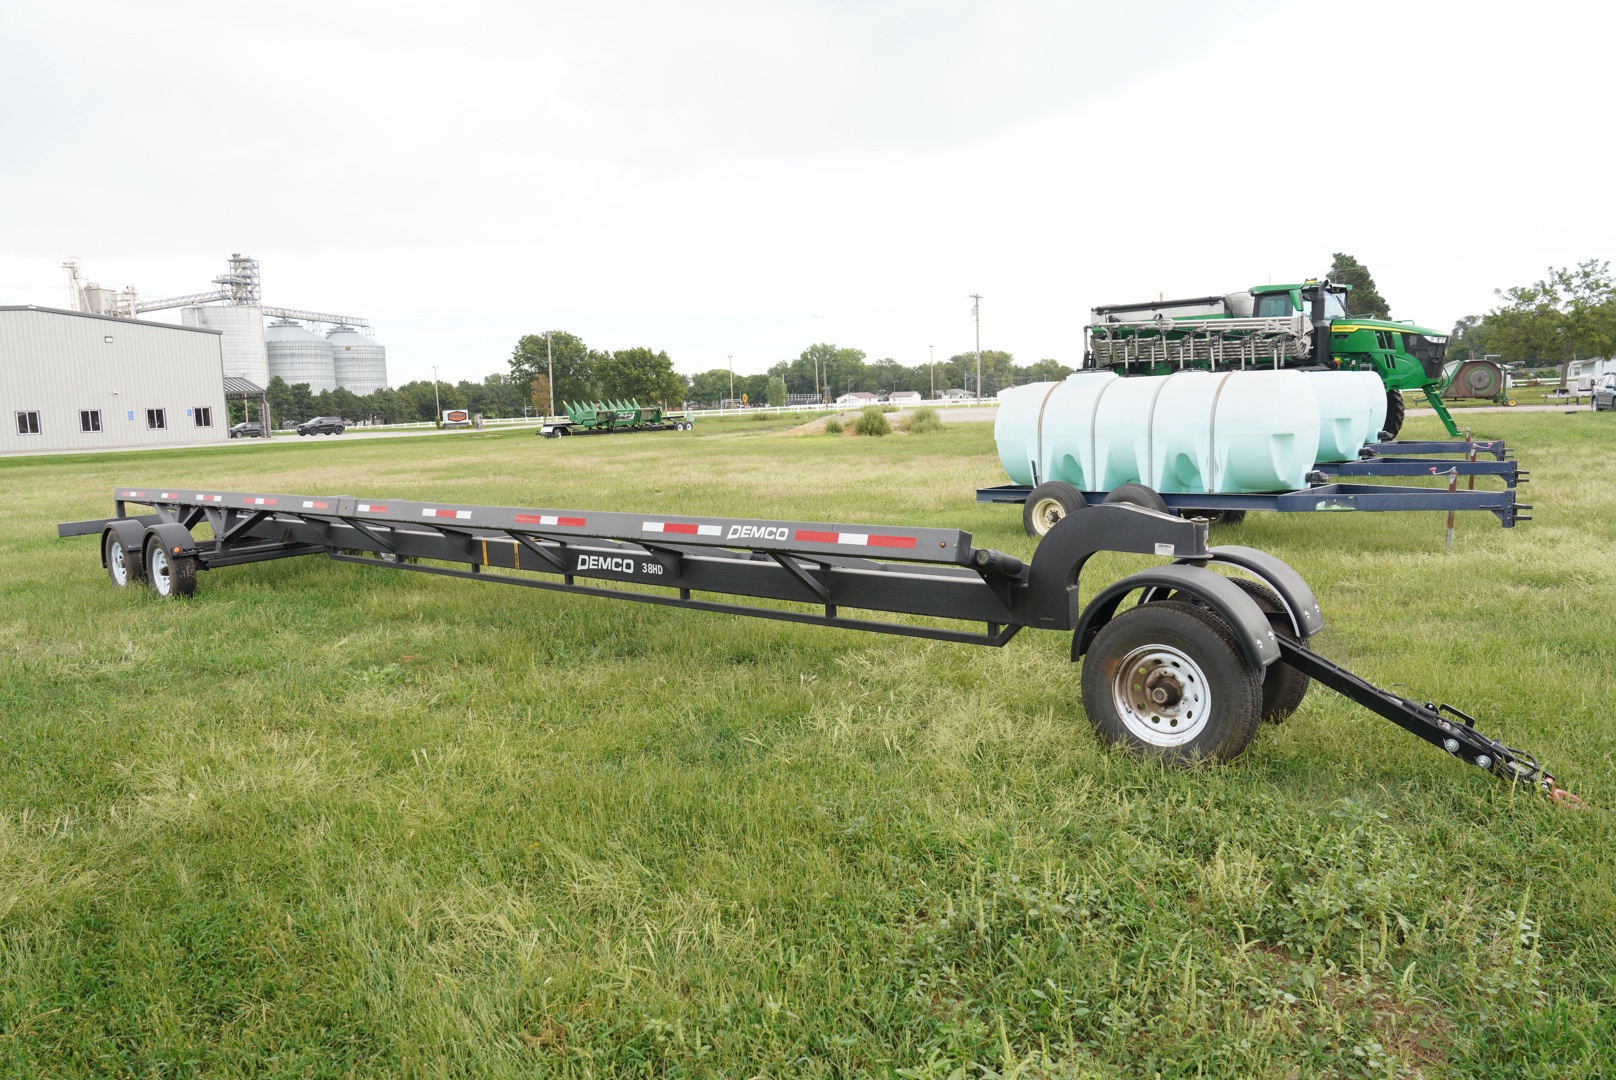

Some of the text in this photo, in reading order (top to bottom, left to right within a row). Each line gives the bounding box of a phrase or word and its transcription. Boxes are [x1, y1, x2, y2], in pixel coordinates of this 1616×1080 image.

[726, 525, 789, 541] DEMCO
[577, 554, 664, 575] DEMCO 38HD
